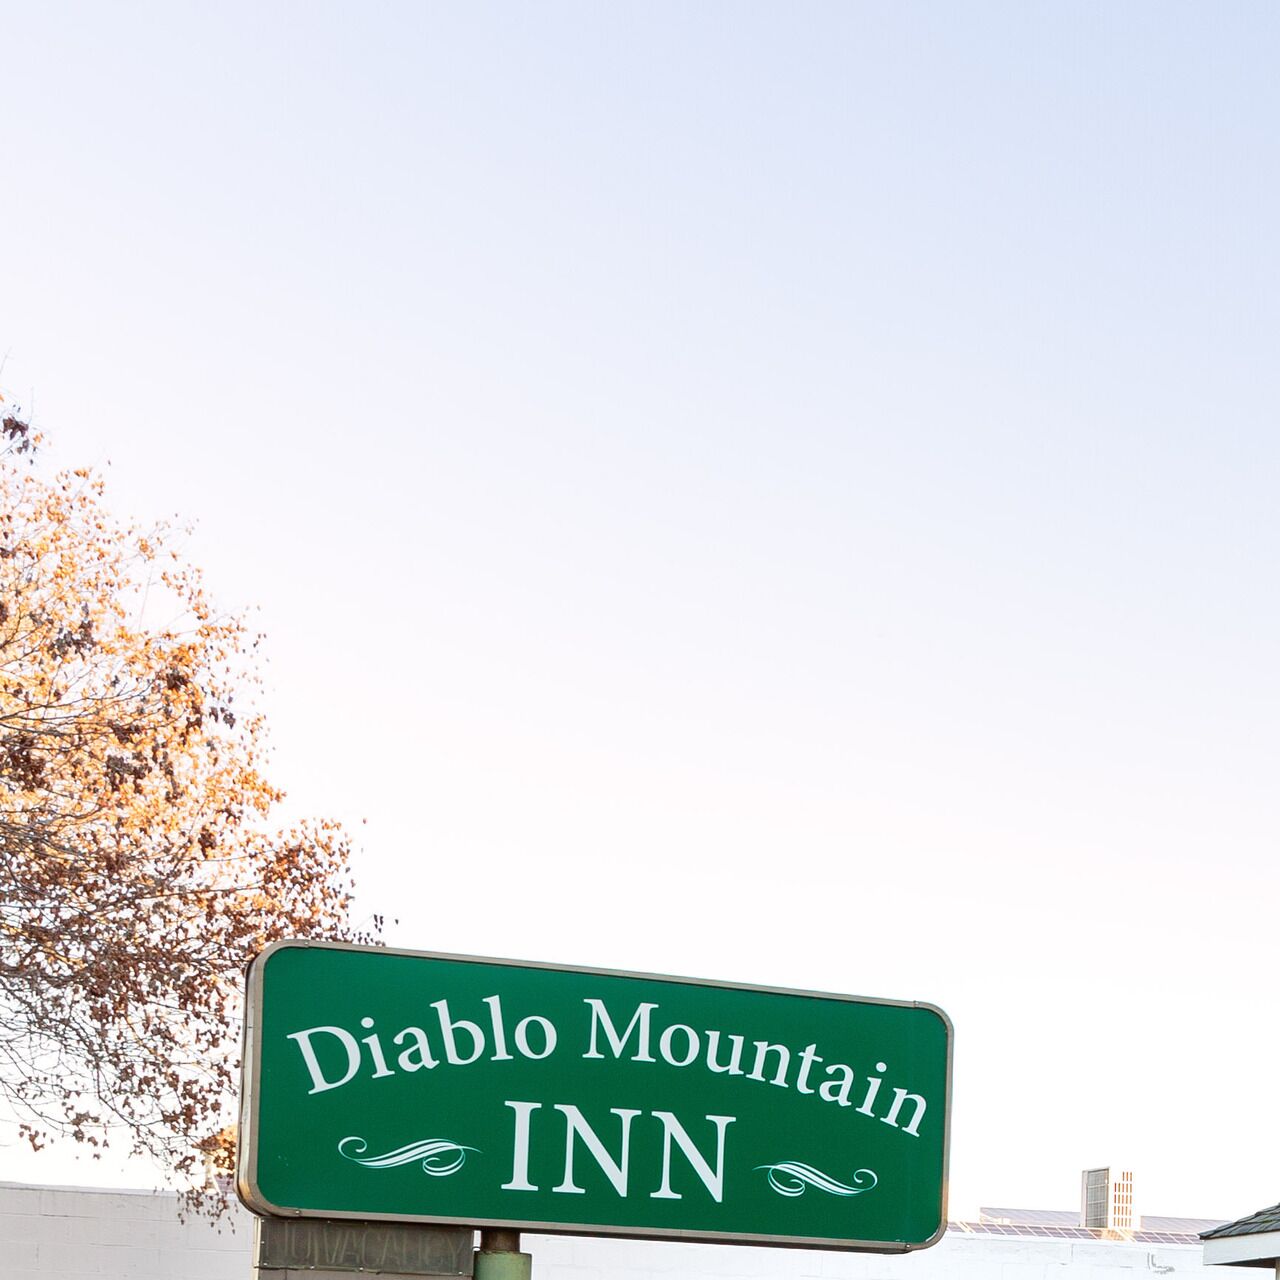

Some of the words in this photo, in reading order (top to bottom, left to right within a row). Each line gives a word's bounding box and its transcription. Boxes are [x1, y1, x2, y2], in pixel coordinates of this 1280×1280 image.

[287, 995, 558, 1096] Diablo
[582, 998, 929, 1139] Mountain
[501, 1100, 737, 1204] INN
